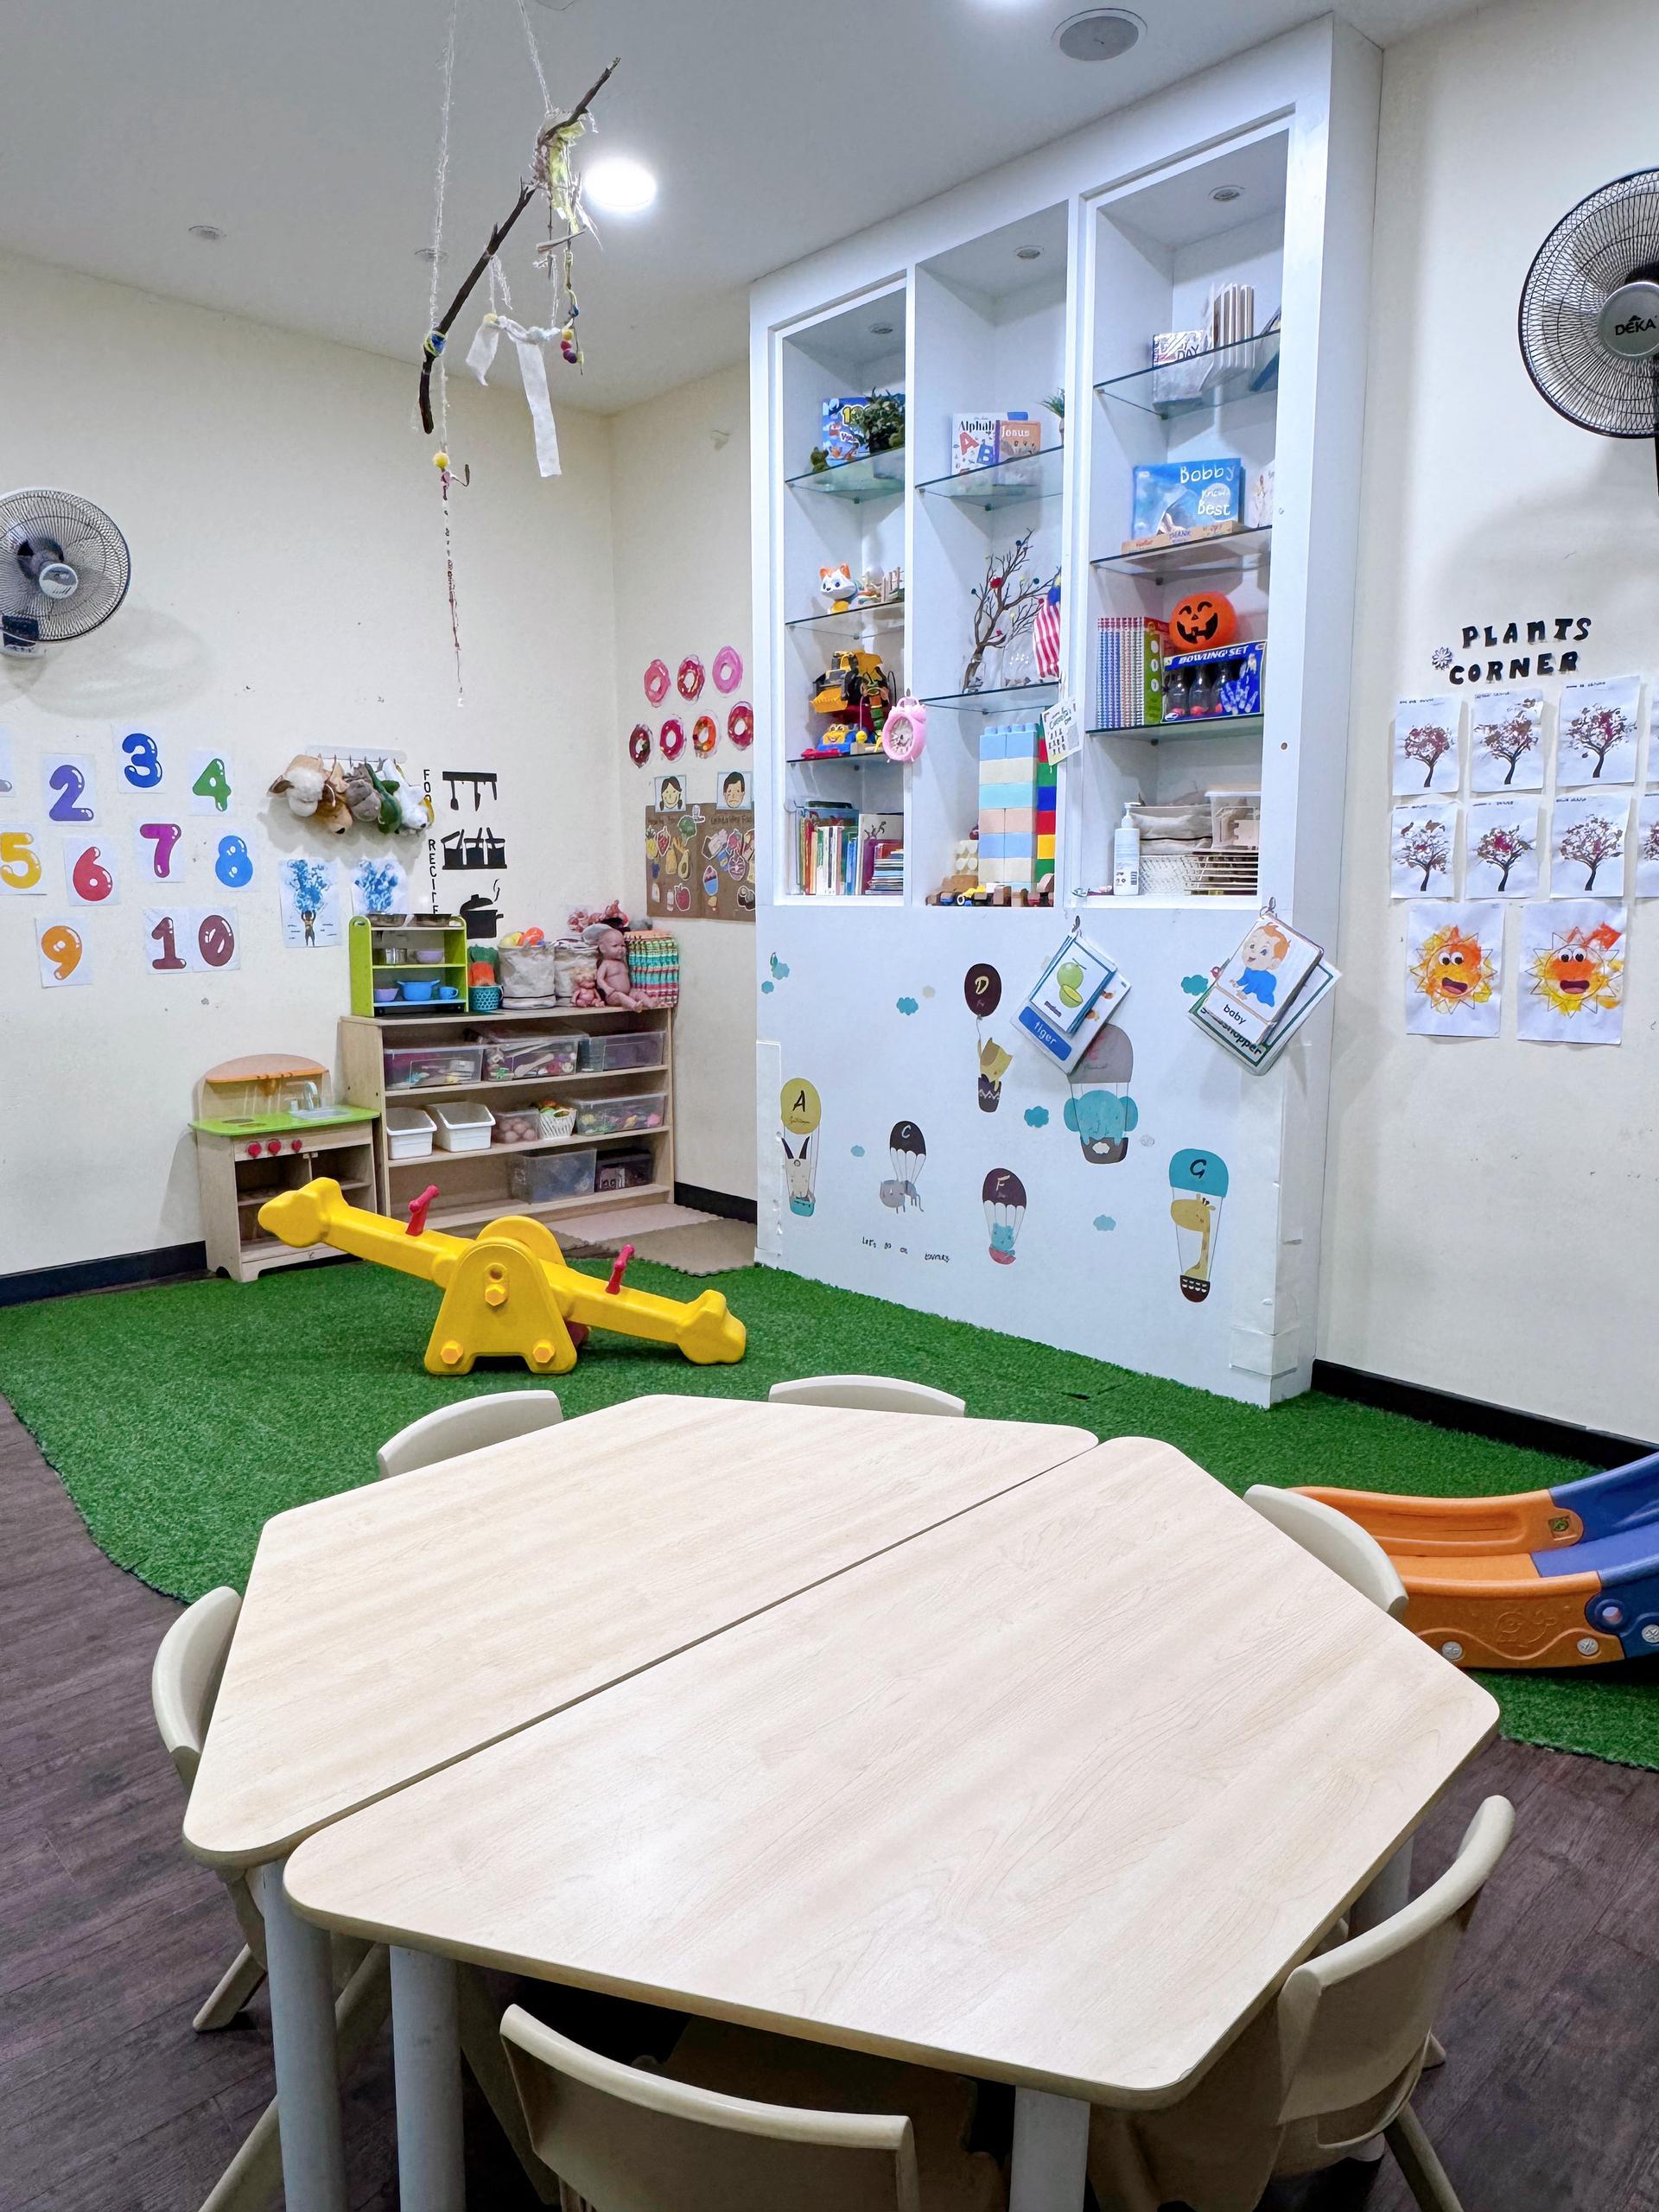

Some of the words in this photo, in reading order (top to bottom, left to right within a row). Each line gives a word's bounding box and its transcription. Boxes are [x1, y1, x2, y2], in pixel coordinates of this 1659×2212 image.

[1615, 318, 1656, 335] DEKA
[1180, 463, 1236, 485] Bobby
[1198, 499, 1231, 516] Best
[1229, 645, 1249, 656] SET
[1449, 651, 1579, 685] CORNER
[122, 733, 162, 788] 3
[49, 764, 94, 822] 2
[192, 758, 232, 811] 4
[0, 832, 41, 889] 5
[140, 823, 181, 878] 7
[215, 835, 253, 888] 8
[73, 846, 112, 901] 6
[41, 925, 82, 980] 9
[151, 914, 235, 969] 10
[975, 976, 989, 995] D
[1224, 1004, 1247, 1025] baby
[1034, 1021, 1058, 1045] tiger
[792, 1090, 805, 1113] A
[901, 1124, 912, 1139] C
